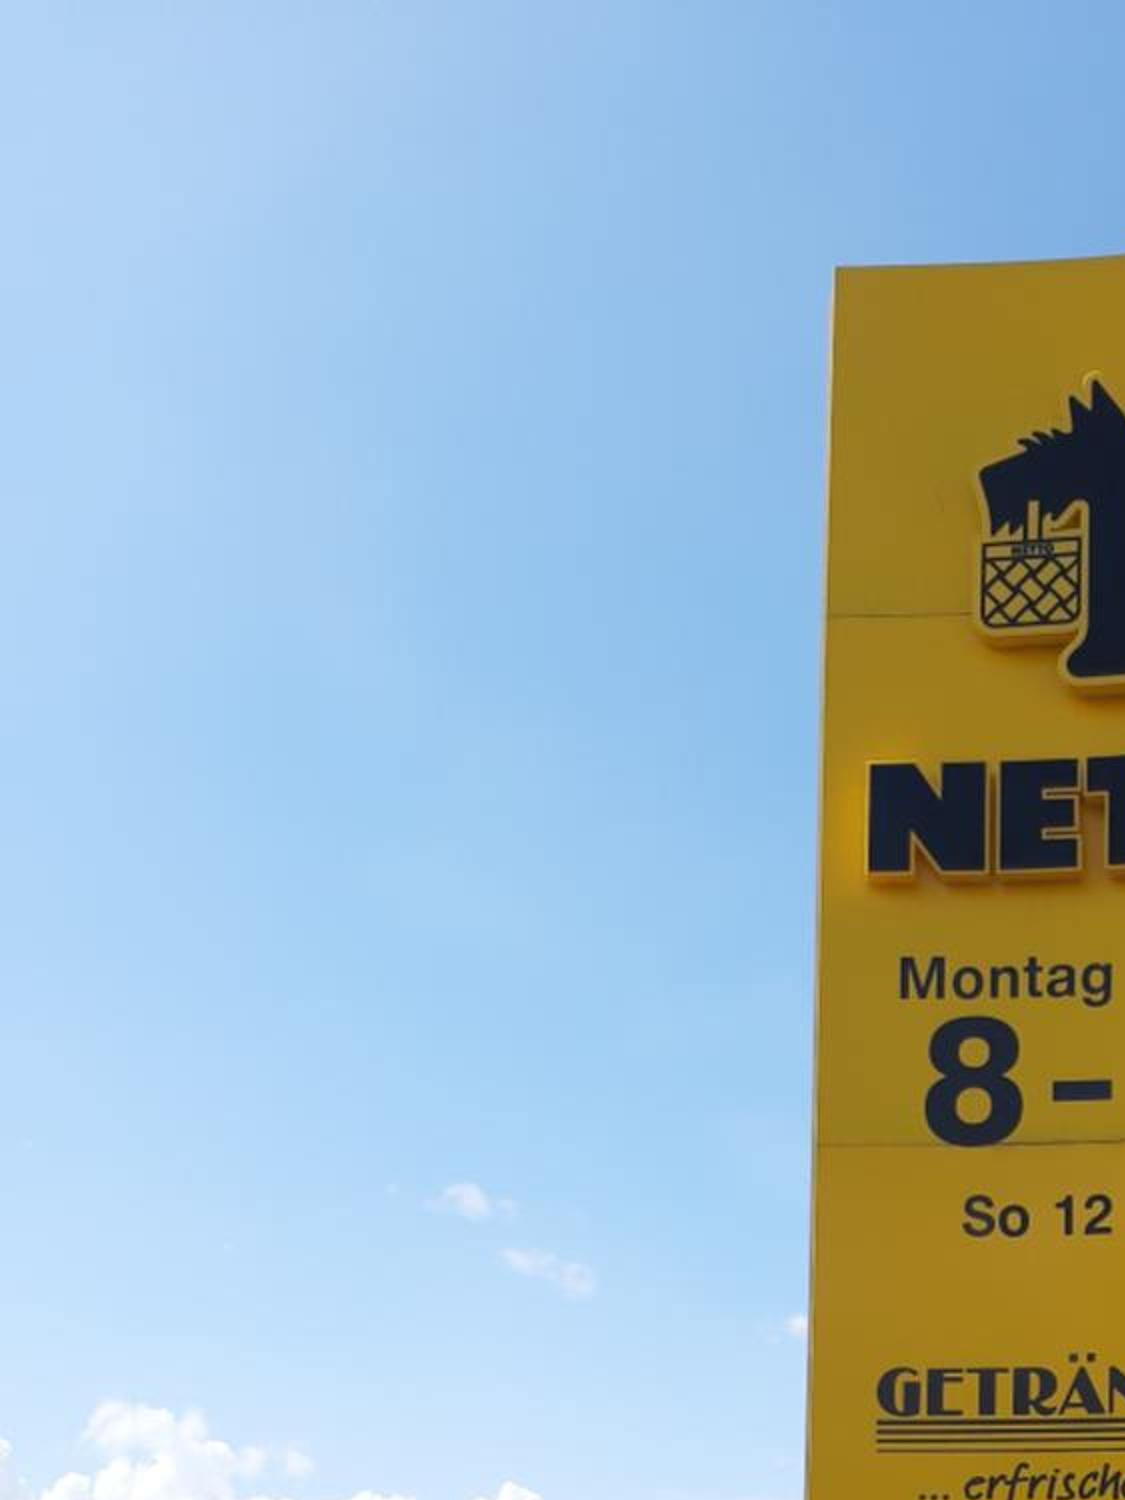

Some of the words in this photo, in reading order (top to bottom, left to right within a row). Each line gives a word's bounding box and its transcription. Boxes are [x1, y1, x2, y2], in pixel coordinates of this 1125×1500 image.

[899, 956, 1113, 1008] Montag
[962, 1194, 1030, 1238] So
[1055, 1194, 1112, 1236] 12
